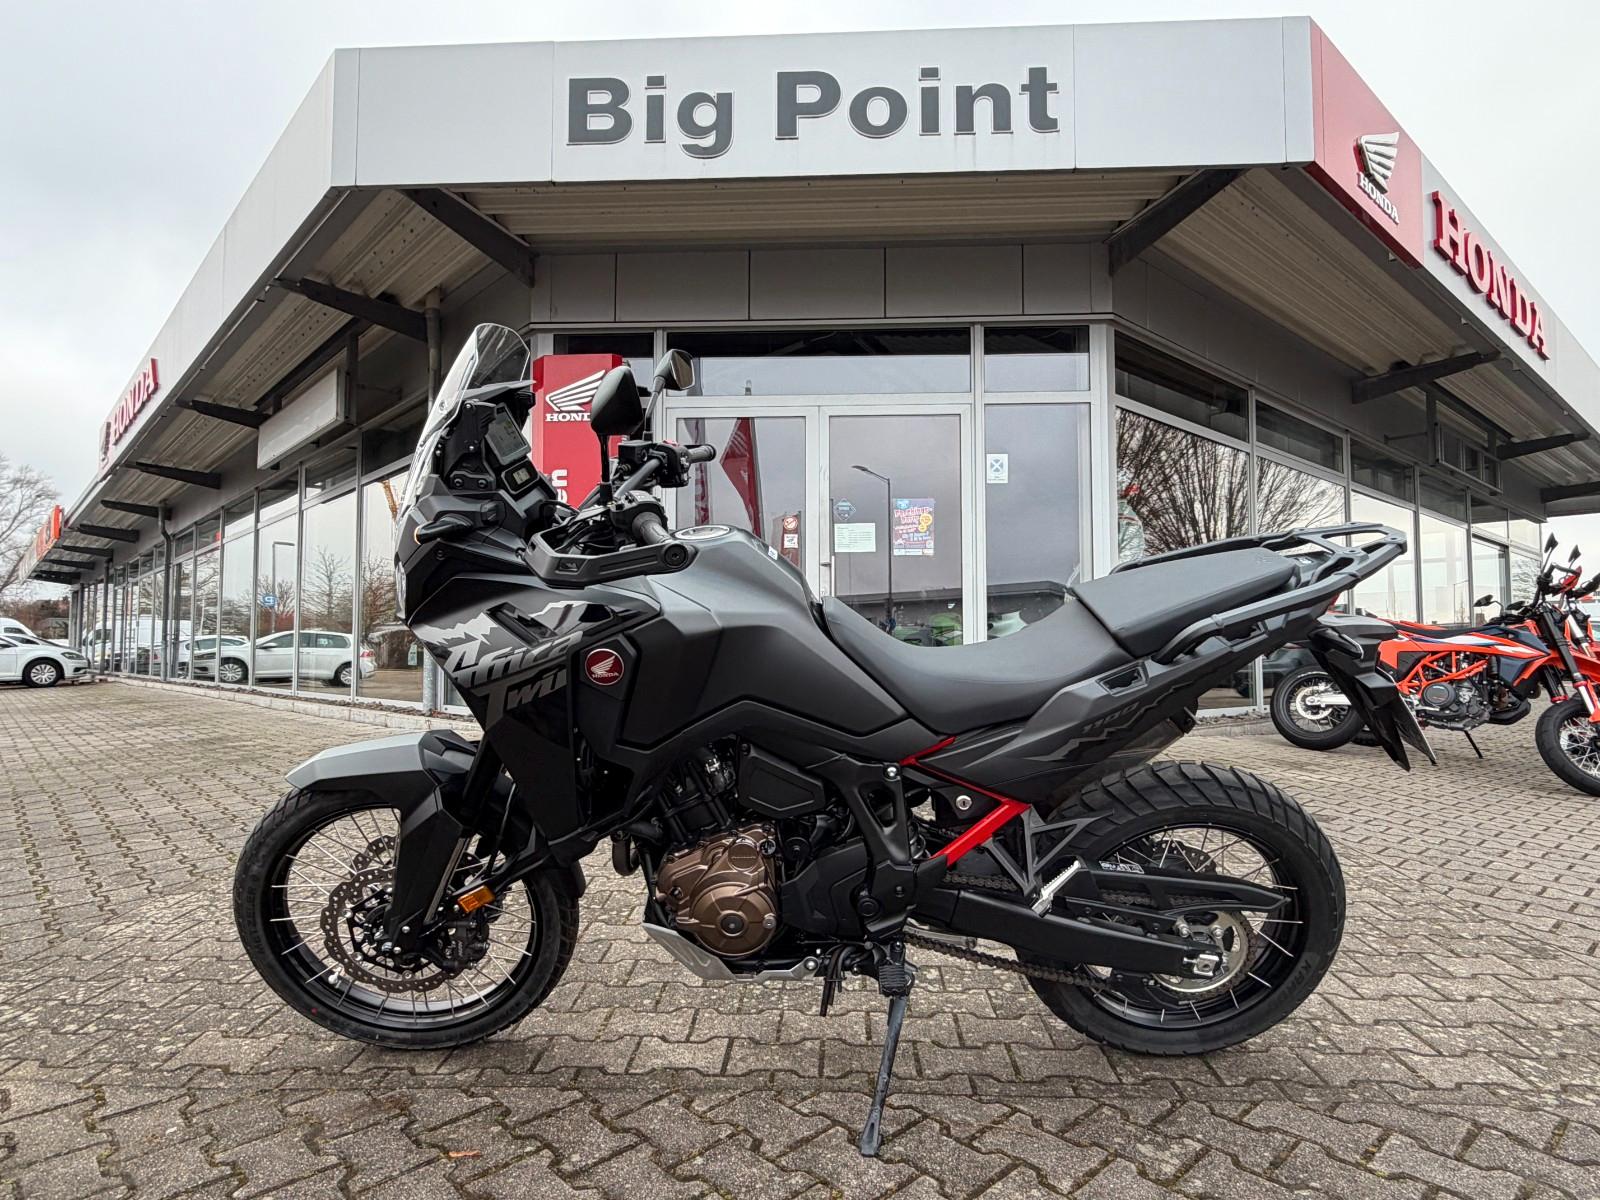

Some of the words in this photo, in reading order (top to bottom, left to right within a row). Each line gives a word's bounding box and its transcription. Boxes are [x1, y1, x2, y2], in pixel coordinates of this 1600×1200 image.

[566, 72, 735, 159] Big
[775, 66, 1062, 141] Point
[1357, 171, 1400, 226] HONDA
[1431, 190, 1550, 361] HONDA
[111, 358, 159, 446] HONDA
